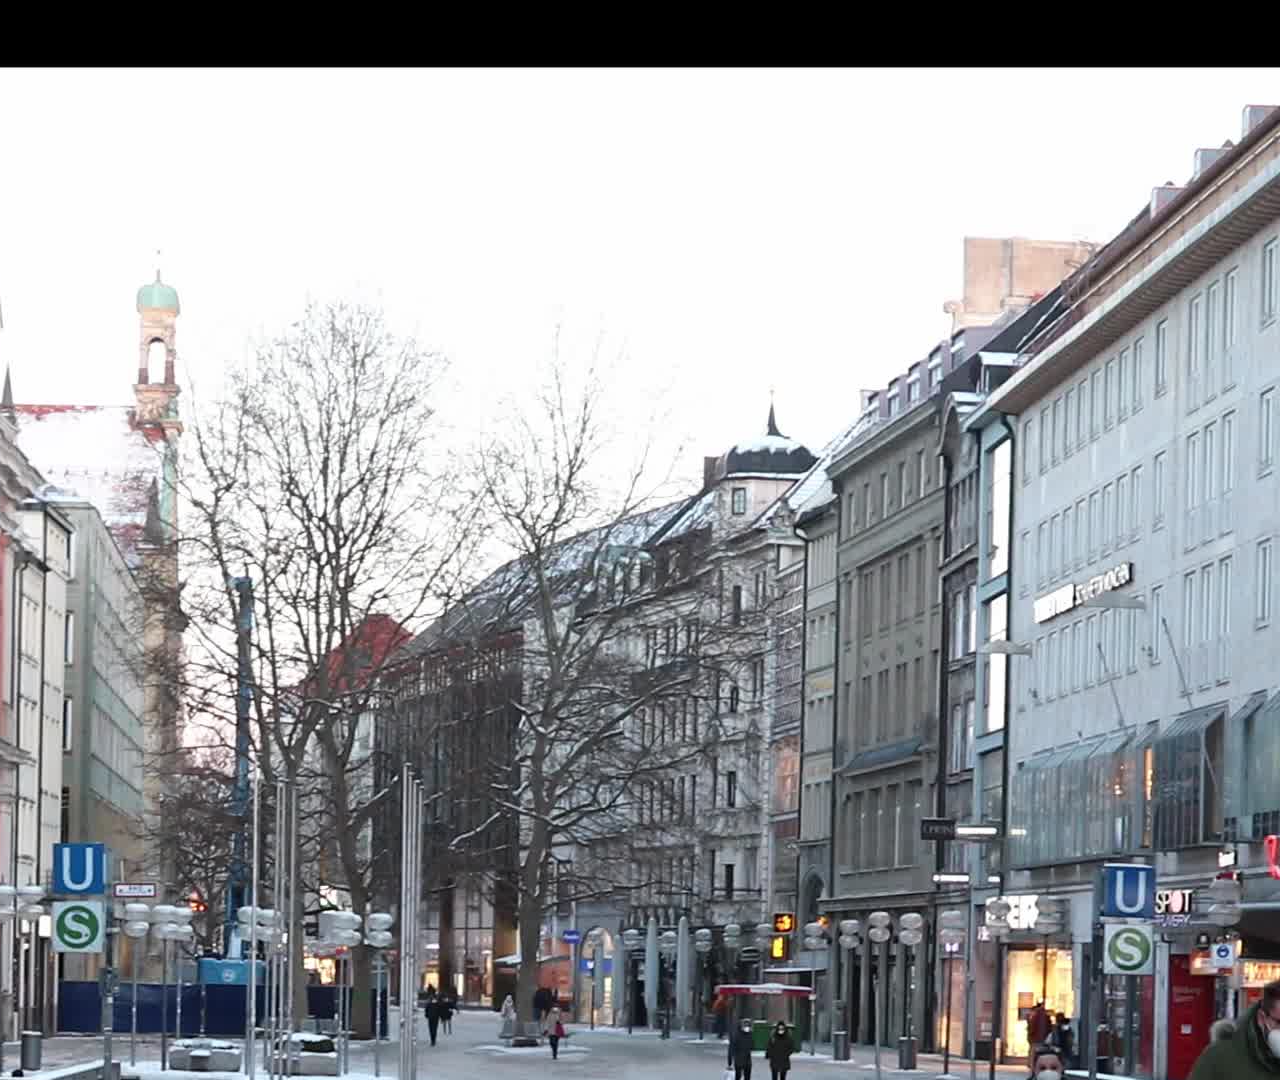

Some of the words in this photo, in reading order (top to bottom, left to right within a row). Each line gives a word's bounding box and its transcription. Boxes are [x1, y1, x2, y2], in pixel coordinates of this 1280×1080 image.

[62, 847, 94, 891] U
[1115, 869, 1147, 913] U
[1154, 889, 1193, 914] SPOT
[63, 910, 92, 945] S
[1115, 931, 1143, 967] S
